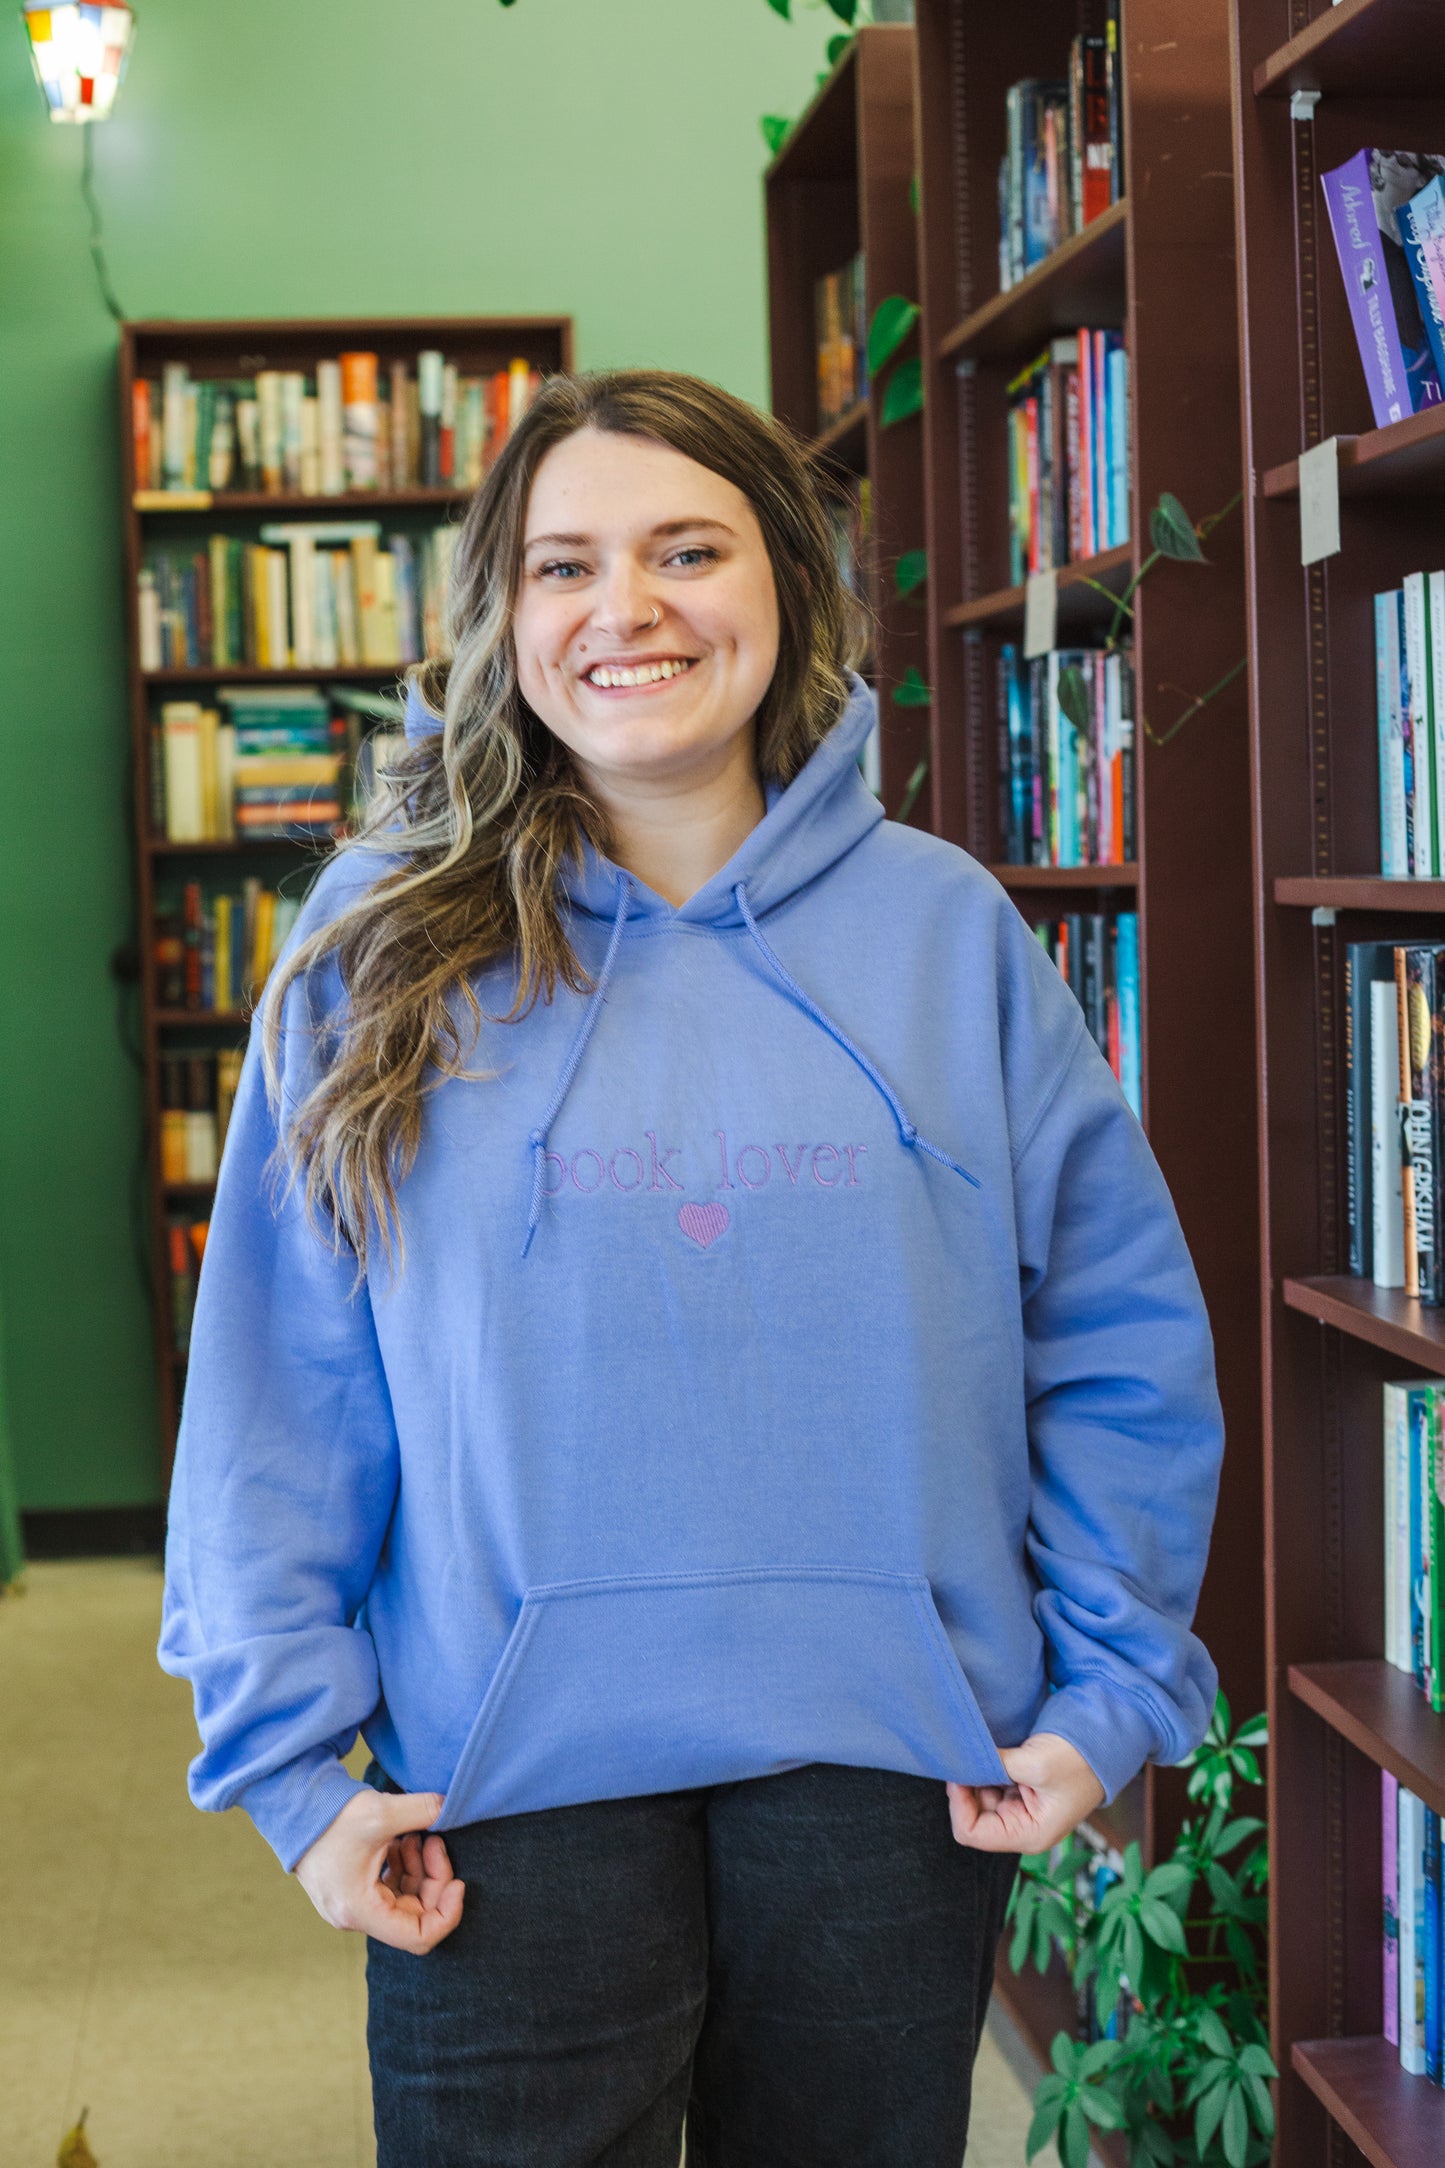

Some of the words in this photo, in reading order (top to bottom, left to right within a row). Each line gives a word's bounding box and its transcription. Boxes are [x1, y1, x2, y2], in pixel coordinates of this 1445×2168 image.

[1411, 1099, 1432, 1155] JOHN
[714, 1131, 867, 1190] lover
[1412, 1157, 1434, 1252] GRISHAM
